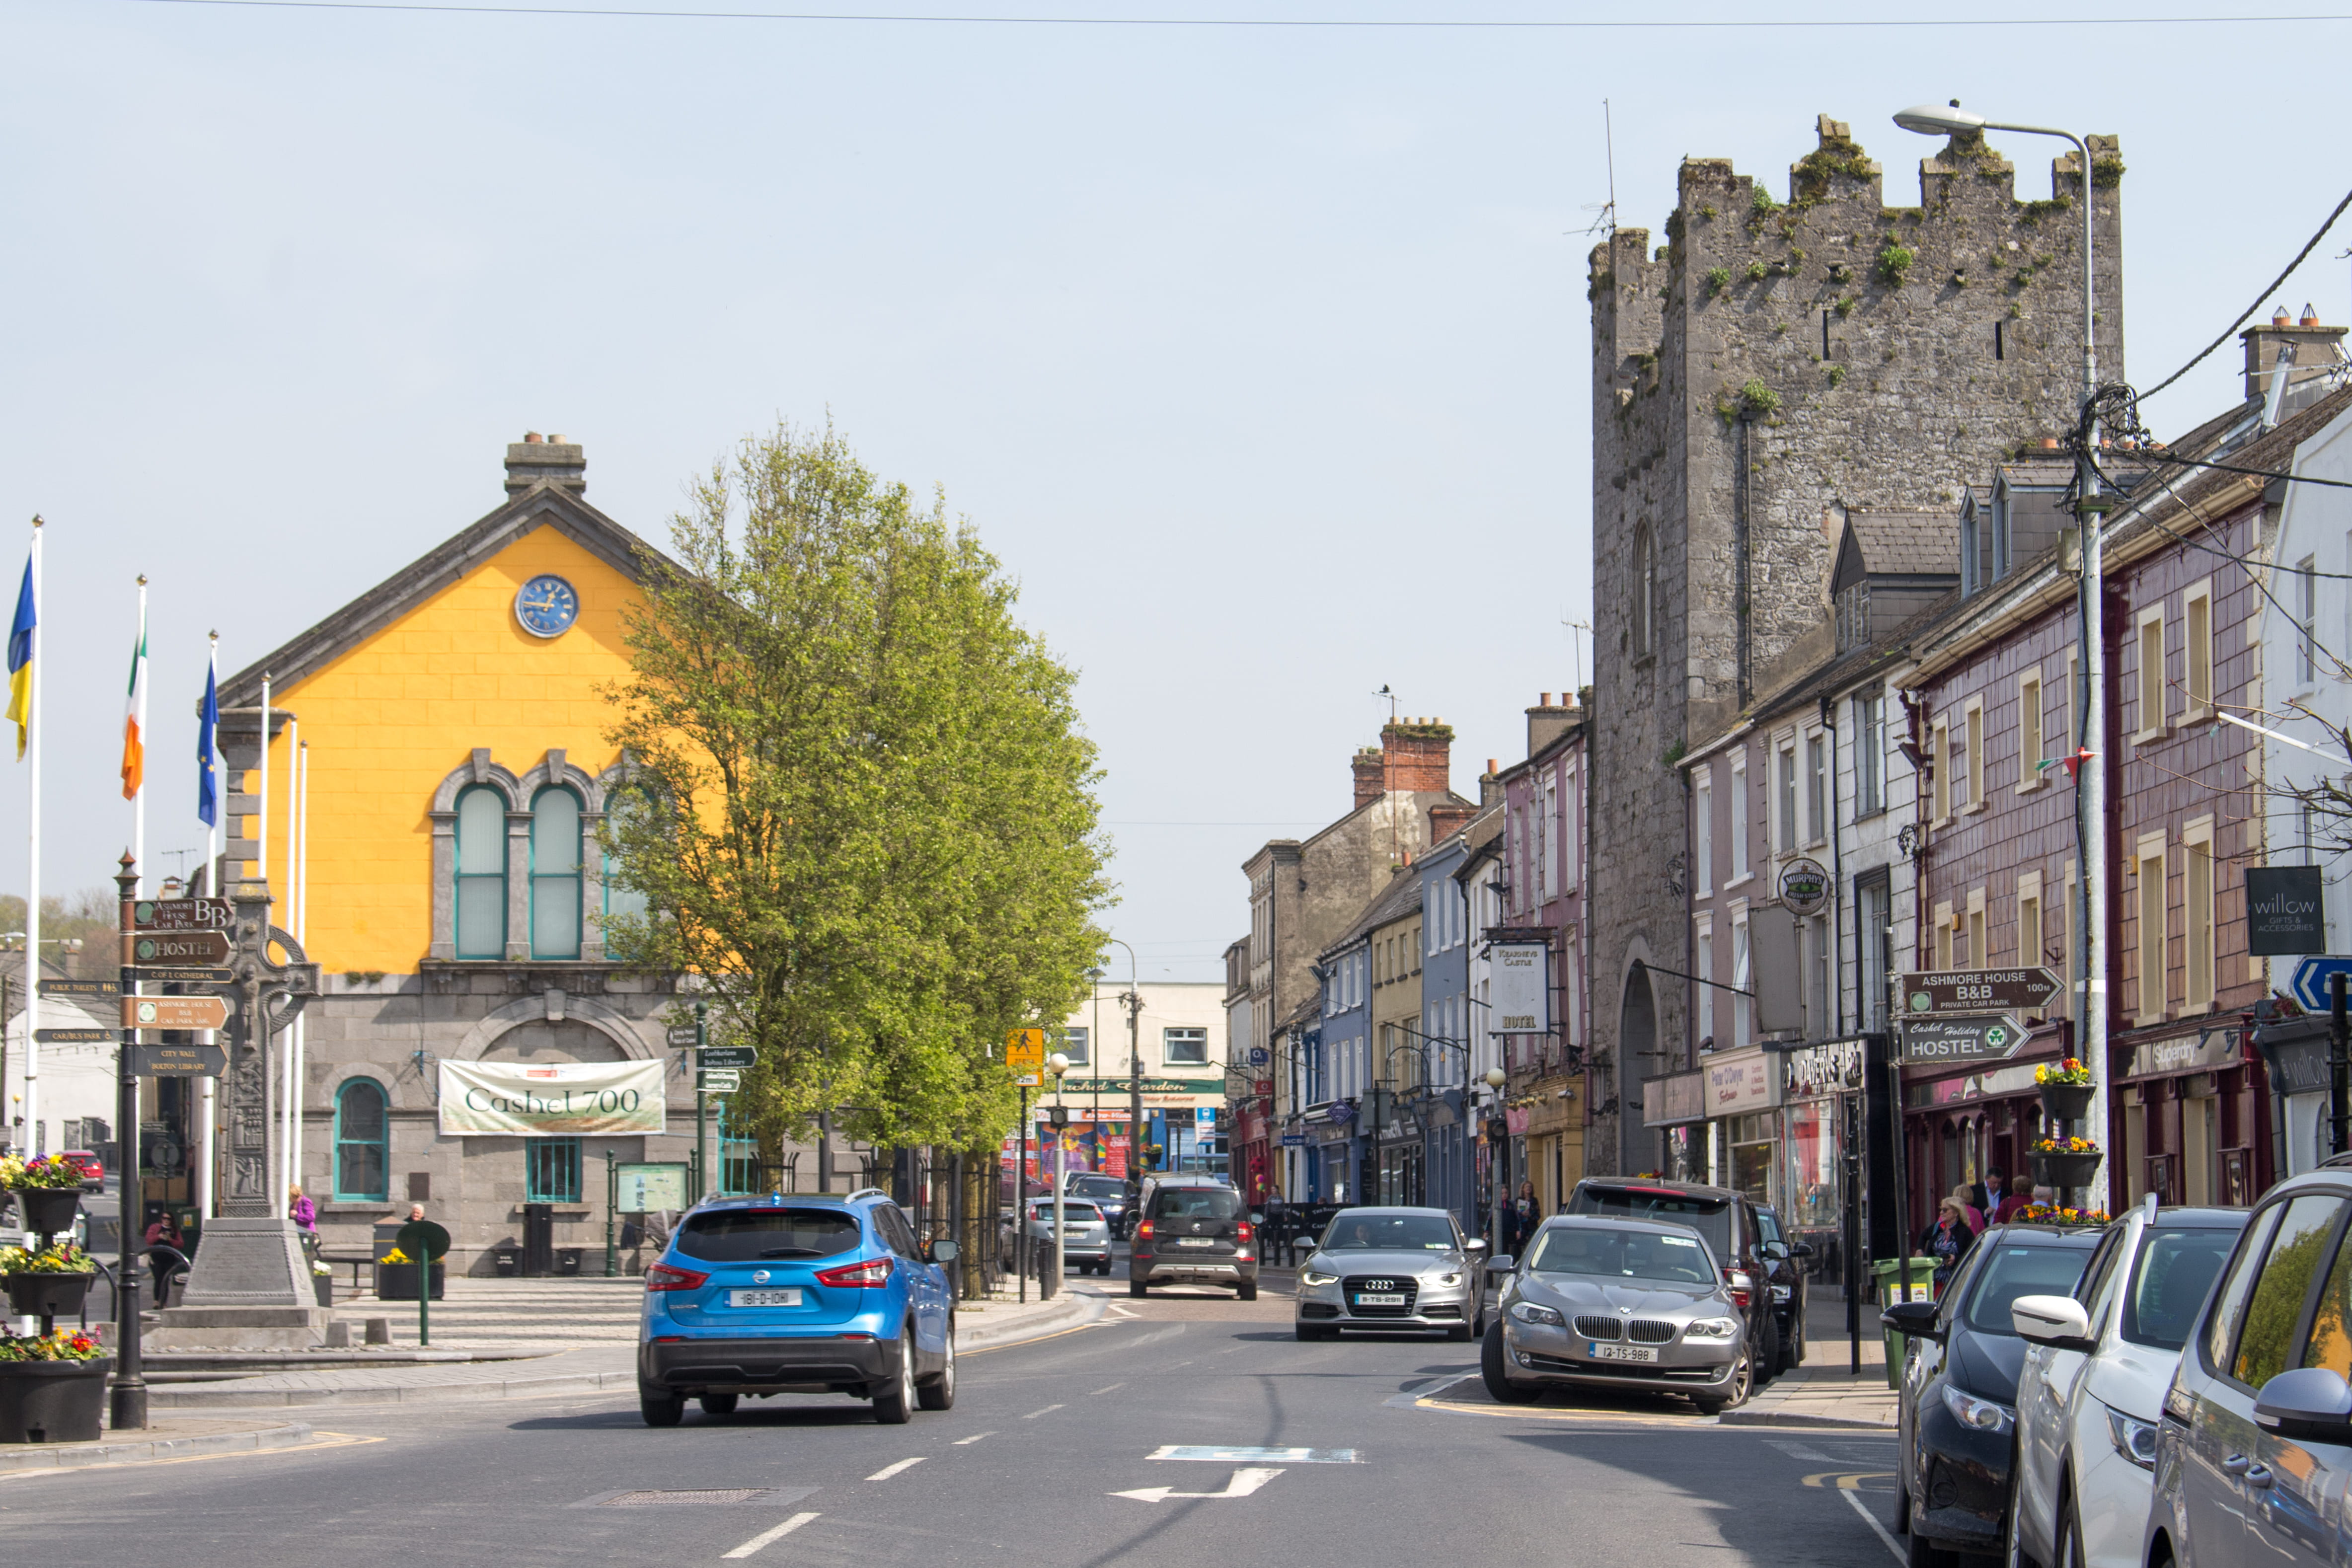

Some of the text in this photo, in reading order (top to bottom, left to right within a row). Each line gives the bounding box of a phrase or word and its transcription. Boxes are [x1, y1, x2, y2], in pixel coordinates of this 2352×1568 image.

[2255, 893, 2315, 914] willow
[154, 920, 195, 929] CAR PARK
[155, 942, 215, 957] HOSTEL
[1922, 972, 2026, 986] ASHMORE HOUSE
[1957, 985, 1992, 999] B&B
[1502, 1016, 1536, 1028] HOTEL
[1910, 1023, 1981, 1037] Cashel Holiday
[1912, 1039, 1983, 1056] HOSTEL
[1799, 1055, 1839, 1086] DAVERNS
[465, 1087, 639, 1115] Cashel 700
[1603, 1347, 1649, 1360] 12-TS-988
